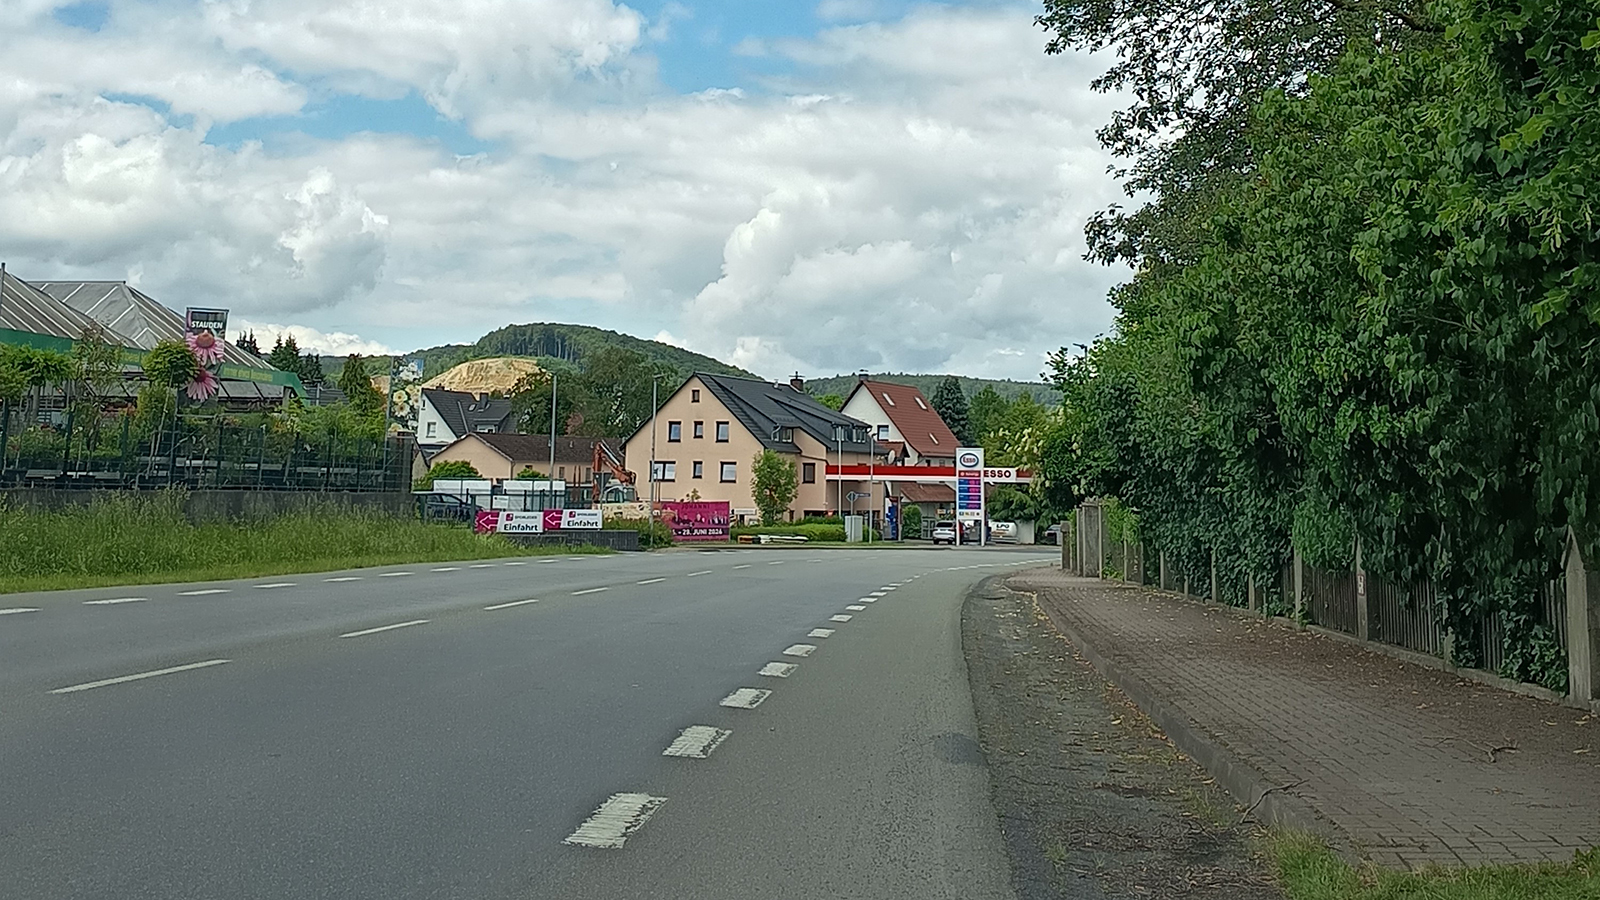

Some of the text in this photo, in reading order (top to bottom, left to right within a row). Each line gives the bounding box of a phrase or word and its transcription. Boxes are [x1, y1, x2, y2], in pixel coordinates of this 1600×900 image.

[191, 321, 223, 329] STAUDEN
[962, 456, 976, 464] Esso
[983, 469, 1012, 478] ESSO
[567, 519, 599, 527] Einfahrt
[693, 528, 708, 536] JUNI
